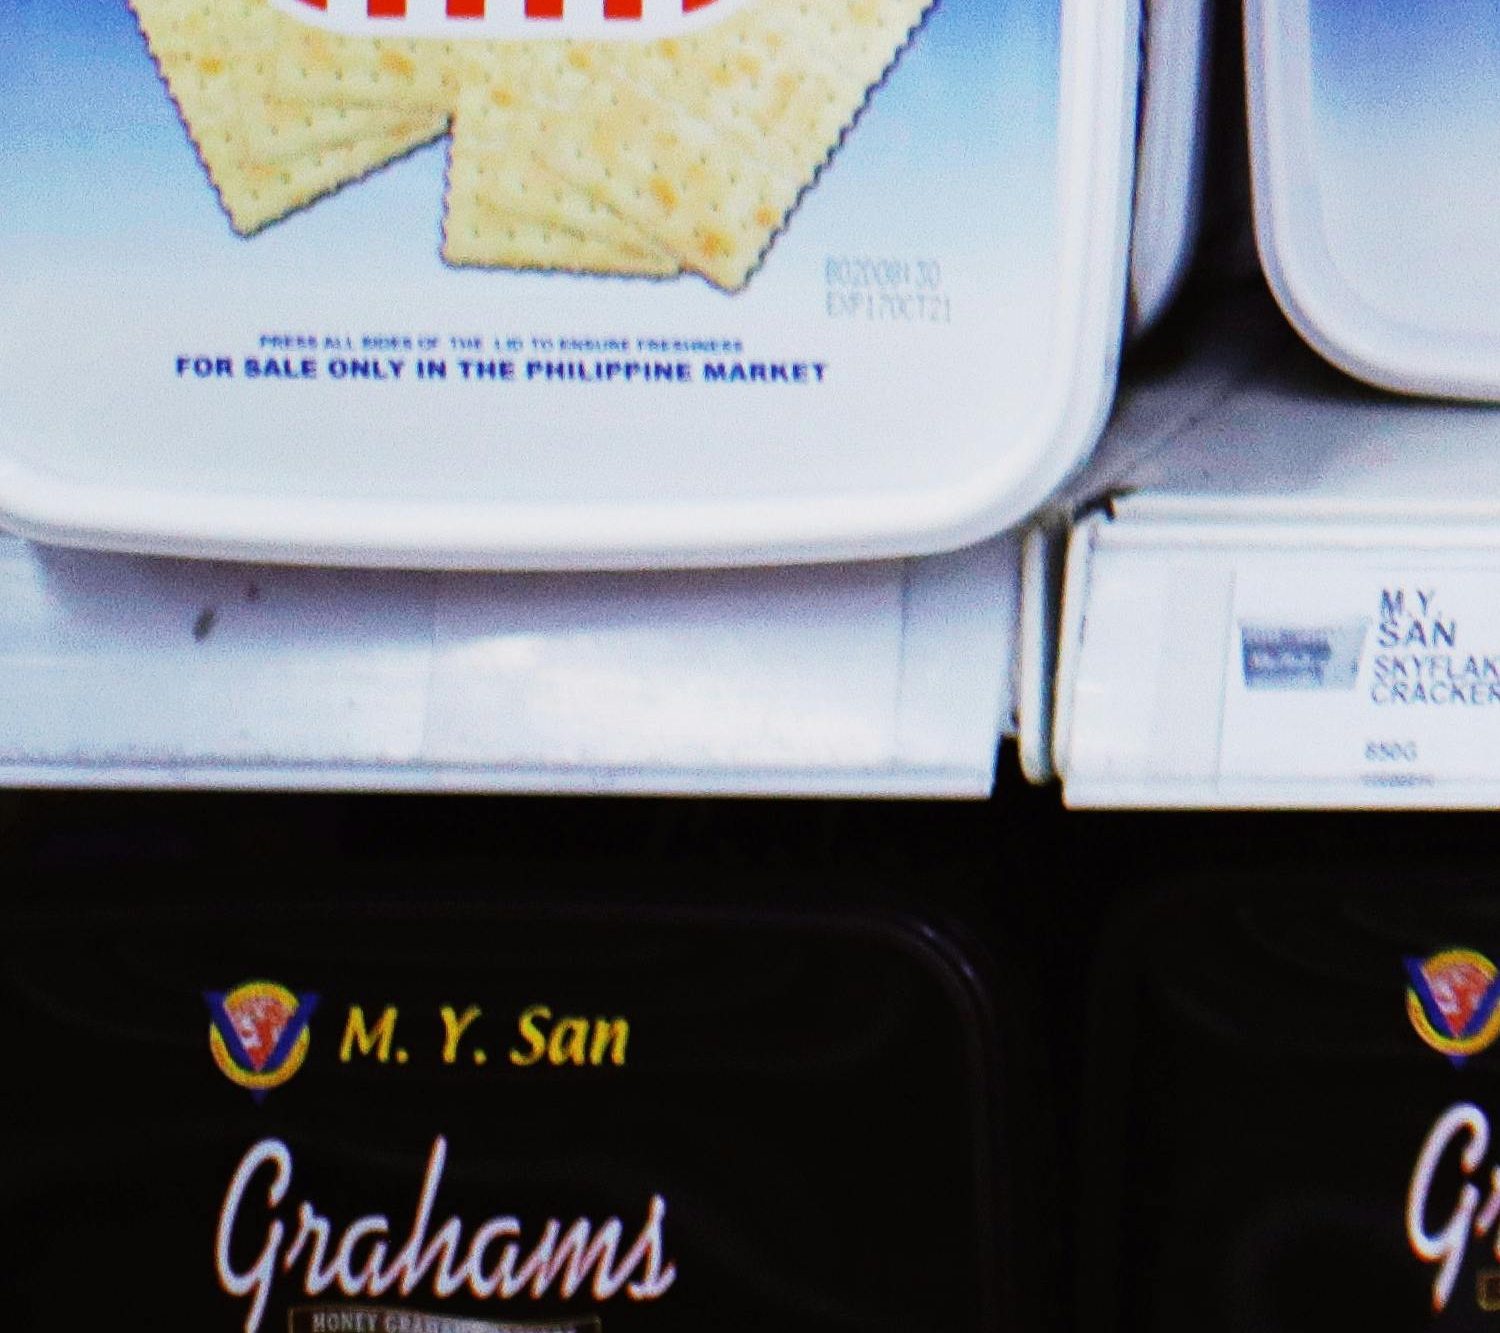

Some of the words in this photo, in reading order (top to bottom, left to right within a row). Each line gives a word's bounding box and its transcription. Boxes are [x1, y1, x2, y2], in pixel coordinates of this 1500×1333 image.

[1380, 588, 1440, 618] M.Y.
[1379, 618, 1455, 646] SAN
[216, 1137, 675, 1333] Grahams
